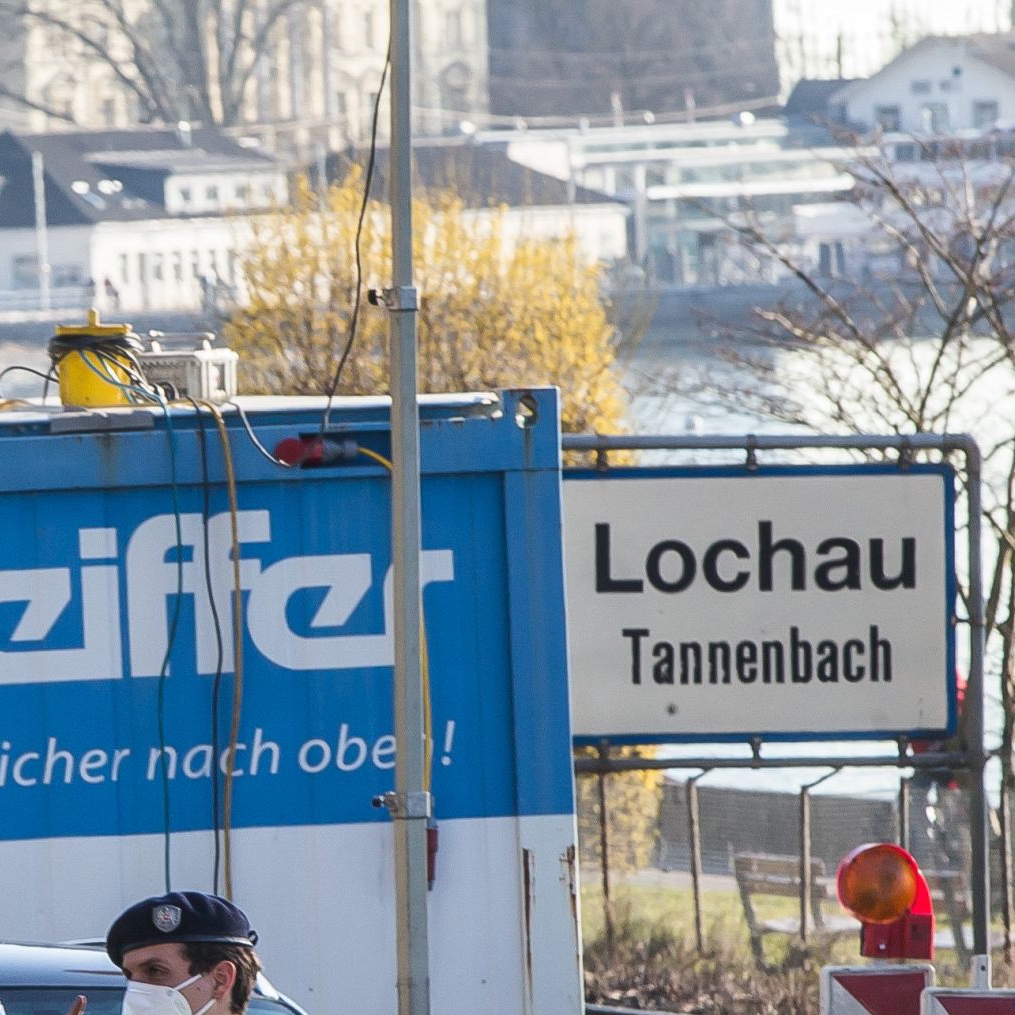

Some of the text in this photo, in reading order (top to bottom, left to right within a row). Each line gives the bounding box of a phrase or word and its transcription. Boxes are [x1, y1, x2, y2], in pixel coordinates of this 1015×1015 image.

[595, 520, 916, 593] Lochau
[621, 624, 892, 685] Tannenbach
[147, 728, 280, 780] nach
[298, 720, 455, 773] obe!
